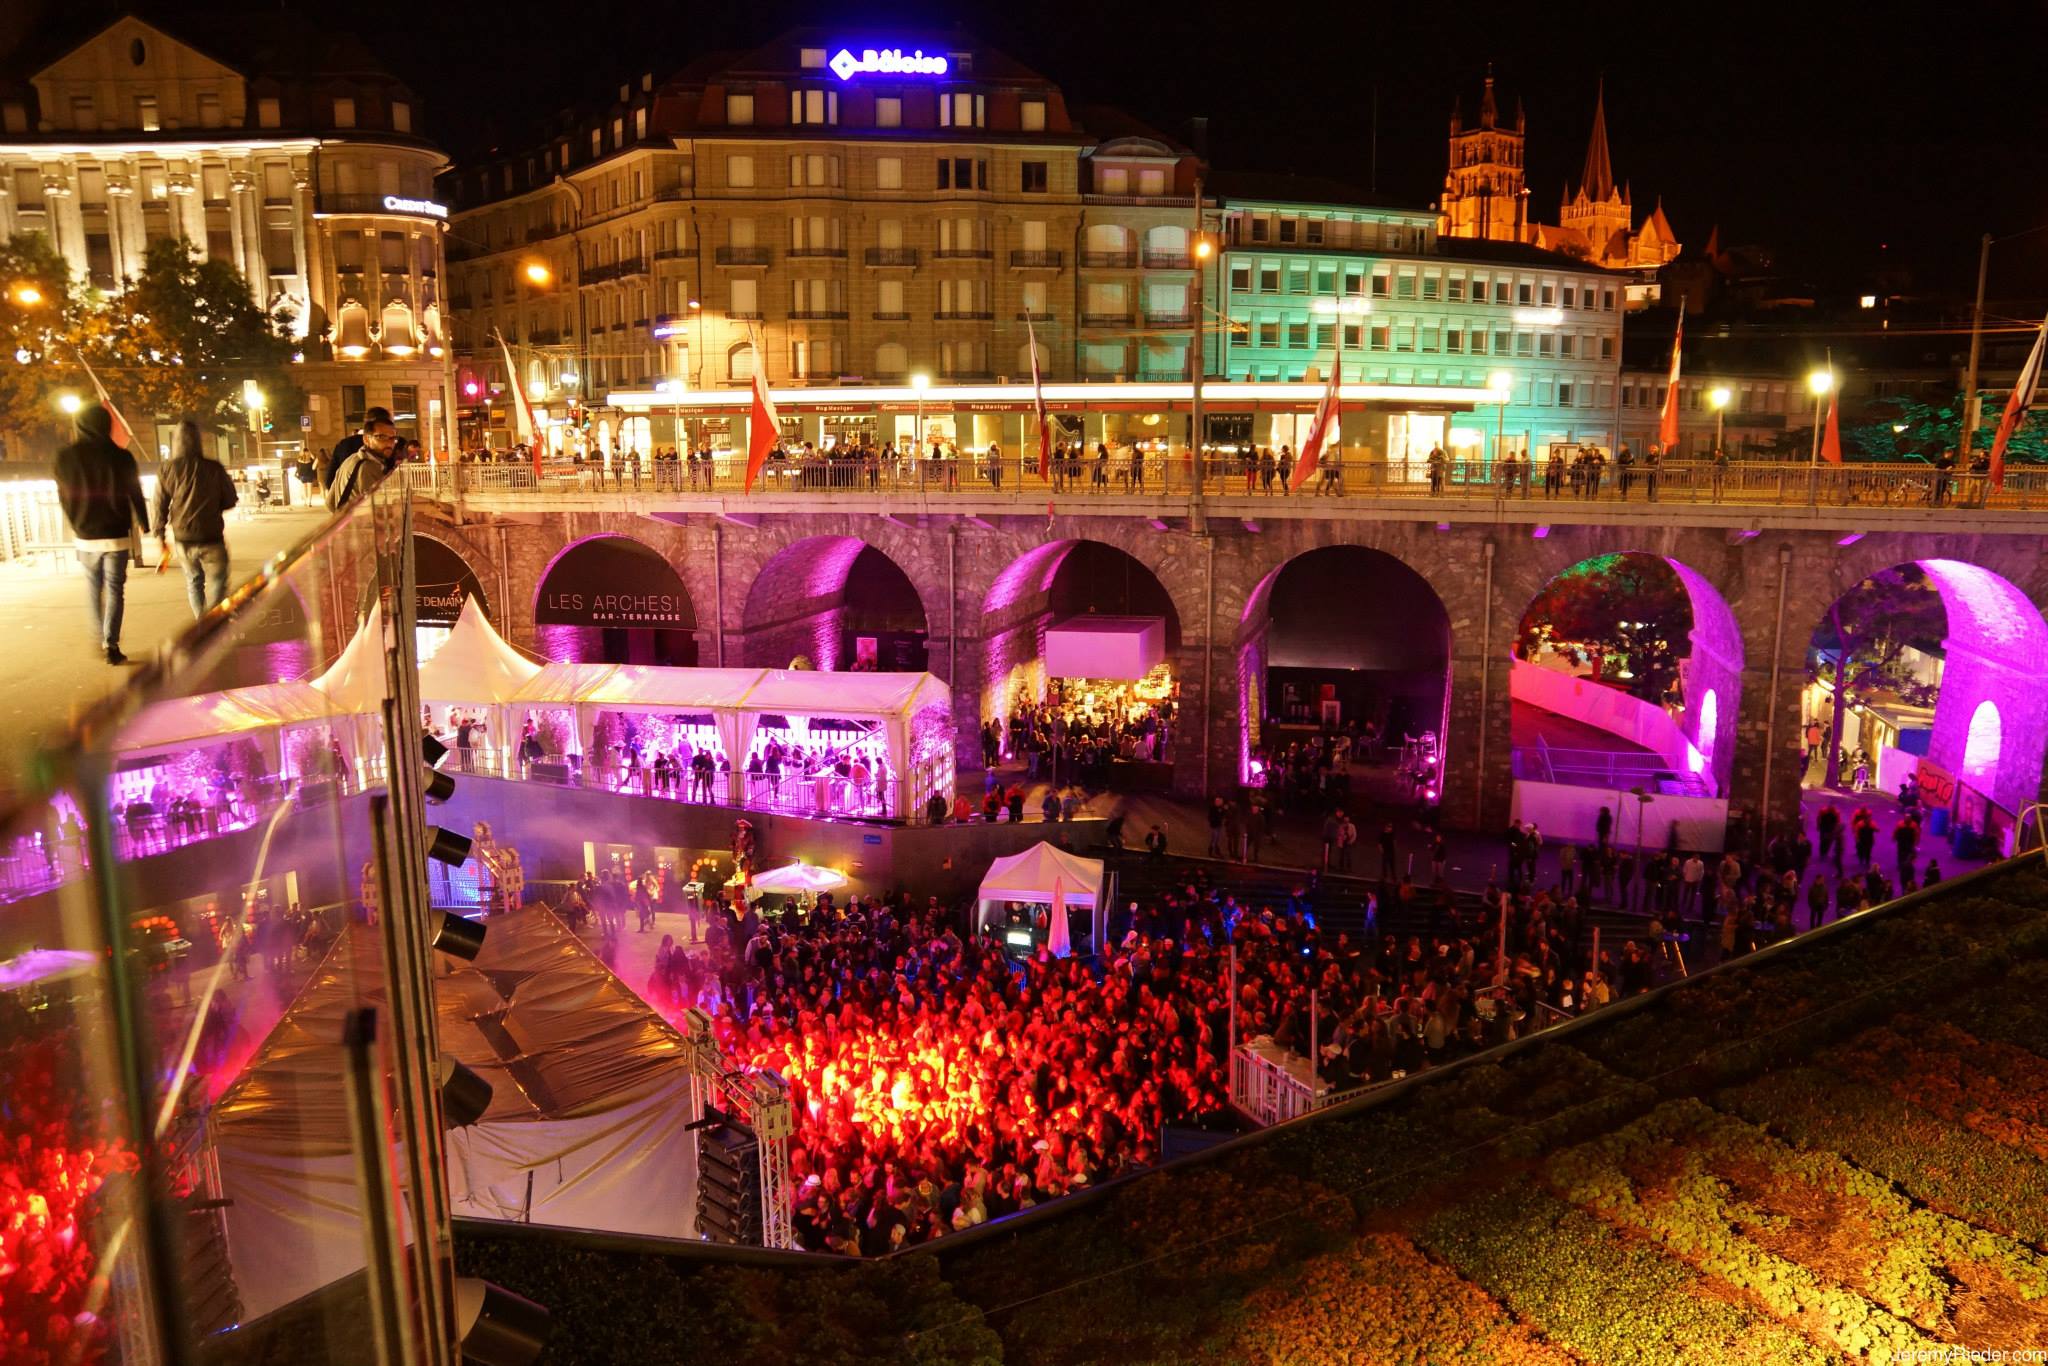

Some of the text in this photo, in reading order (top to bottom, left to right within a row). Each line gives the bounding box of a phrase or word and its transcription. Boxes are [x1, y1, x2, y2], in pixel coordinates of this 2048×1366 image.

[549, 593, 680, 612] LES ARCHES!
[593, 613, 681, 621] BAR-TERRASSE
